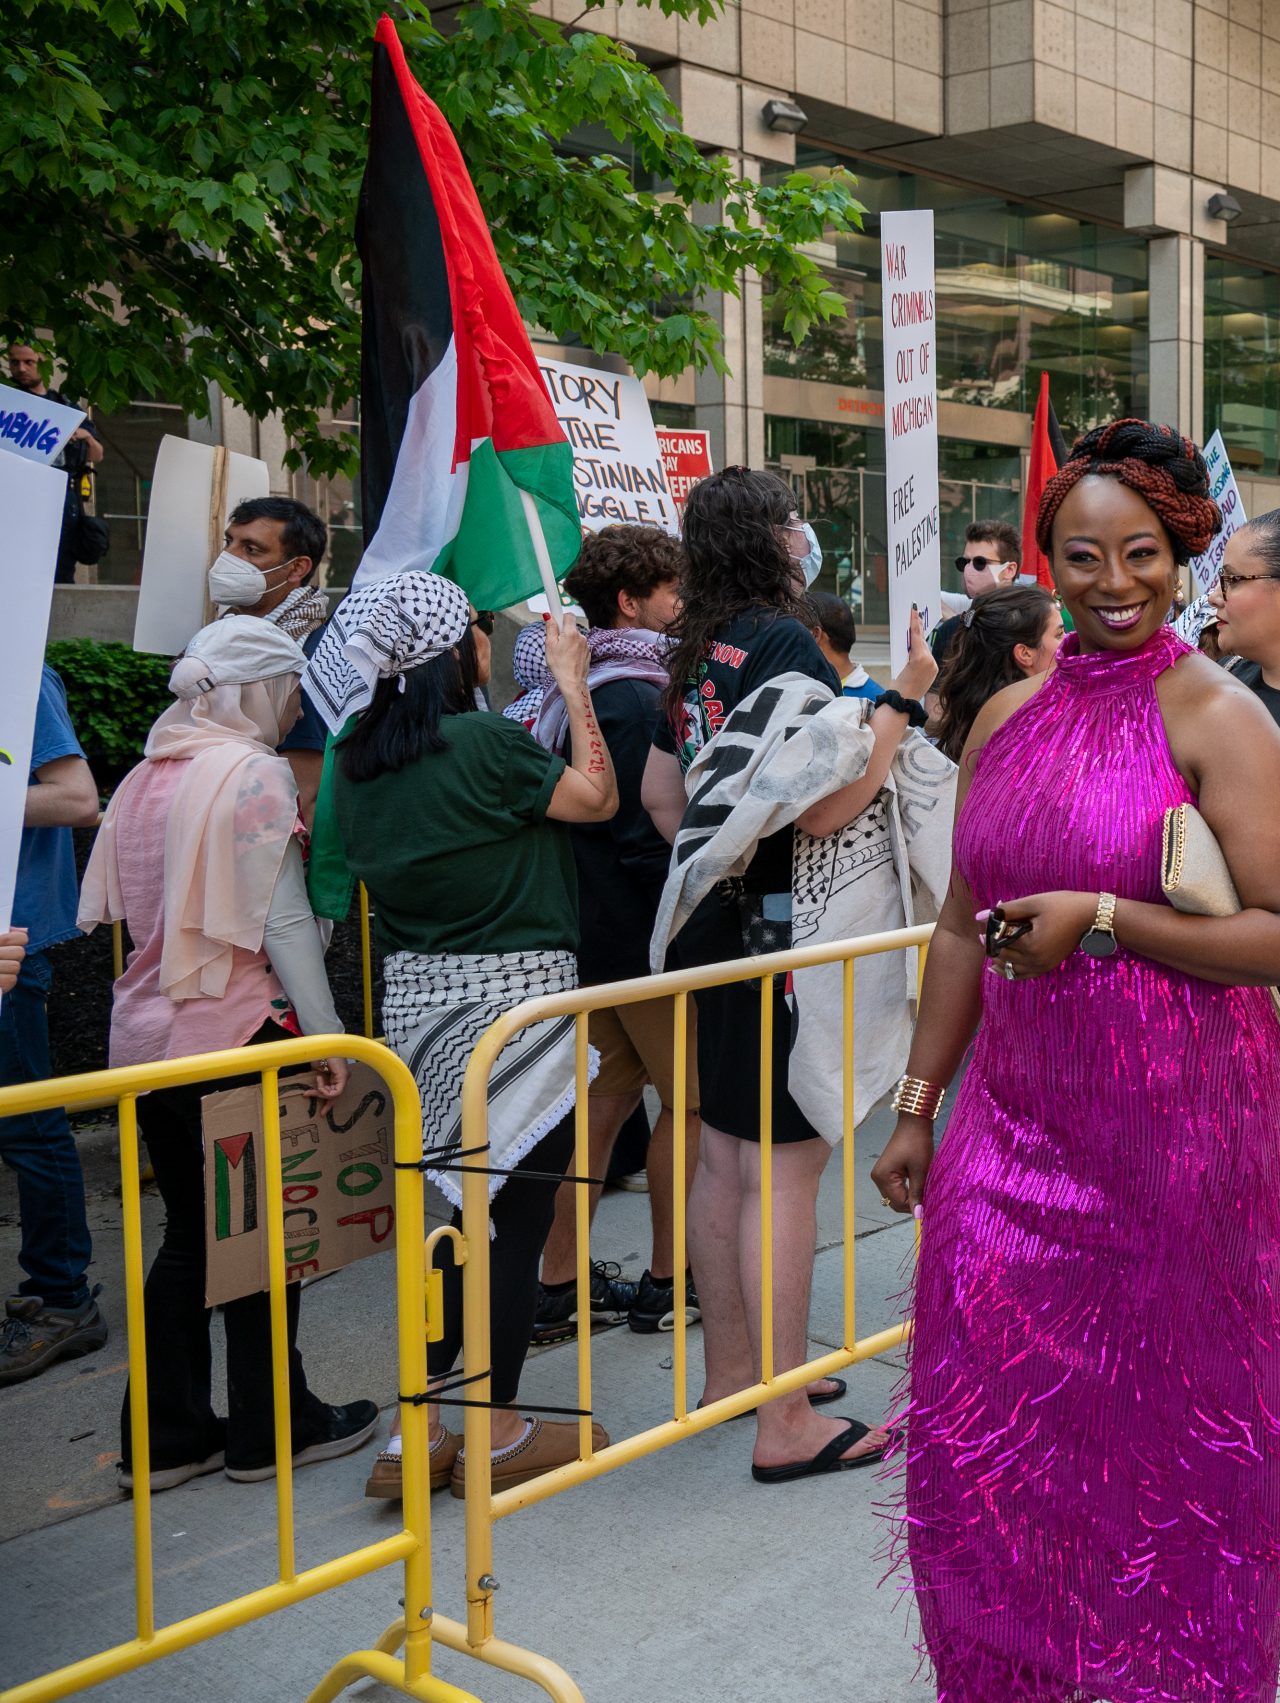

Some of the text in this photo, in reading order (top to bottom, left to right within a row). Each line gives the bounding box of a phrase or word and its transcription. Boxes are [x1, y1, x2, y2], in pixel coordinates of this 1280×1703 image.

[886, 243, 907, 281] WAR
[891, 290, 934, 328] CRIMINALS
[896, 342, 930, 383] OUT OF
[540, 366, 620, 420] TORY
[836, 398, 885, 416] DETROI
[558, 417, 620, 452] THE
[892, 392, 933, 440] MICHIGAN
[657, 438, 703, 454] RICANS
[1206, 446, 1220, 472] THE
[573, 456, 668, 494] STINIAN
[893, 474, 915, 524] FREE
[1220, 489, 1236, 524] AID
[895, 505, 938, 577] PALESTINE
[1199, 566, 1210, 584] TO
[326, 1090, 394, 1244] STOP
